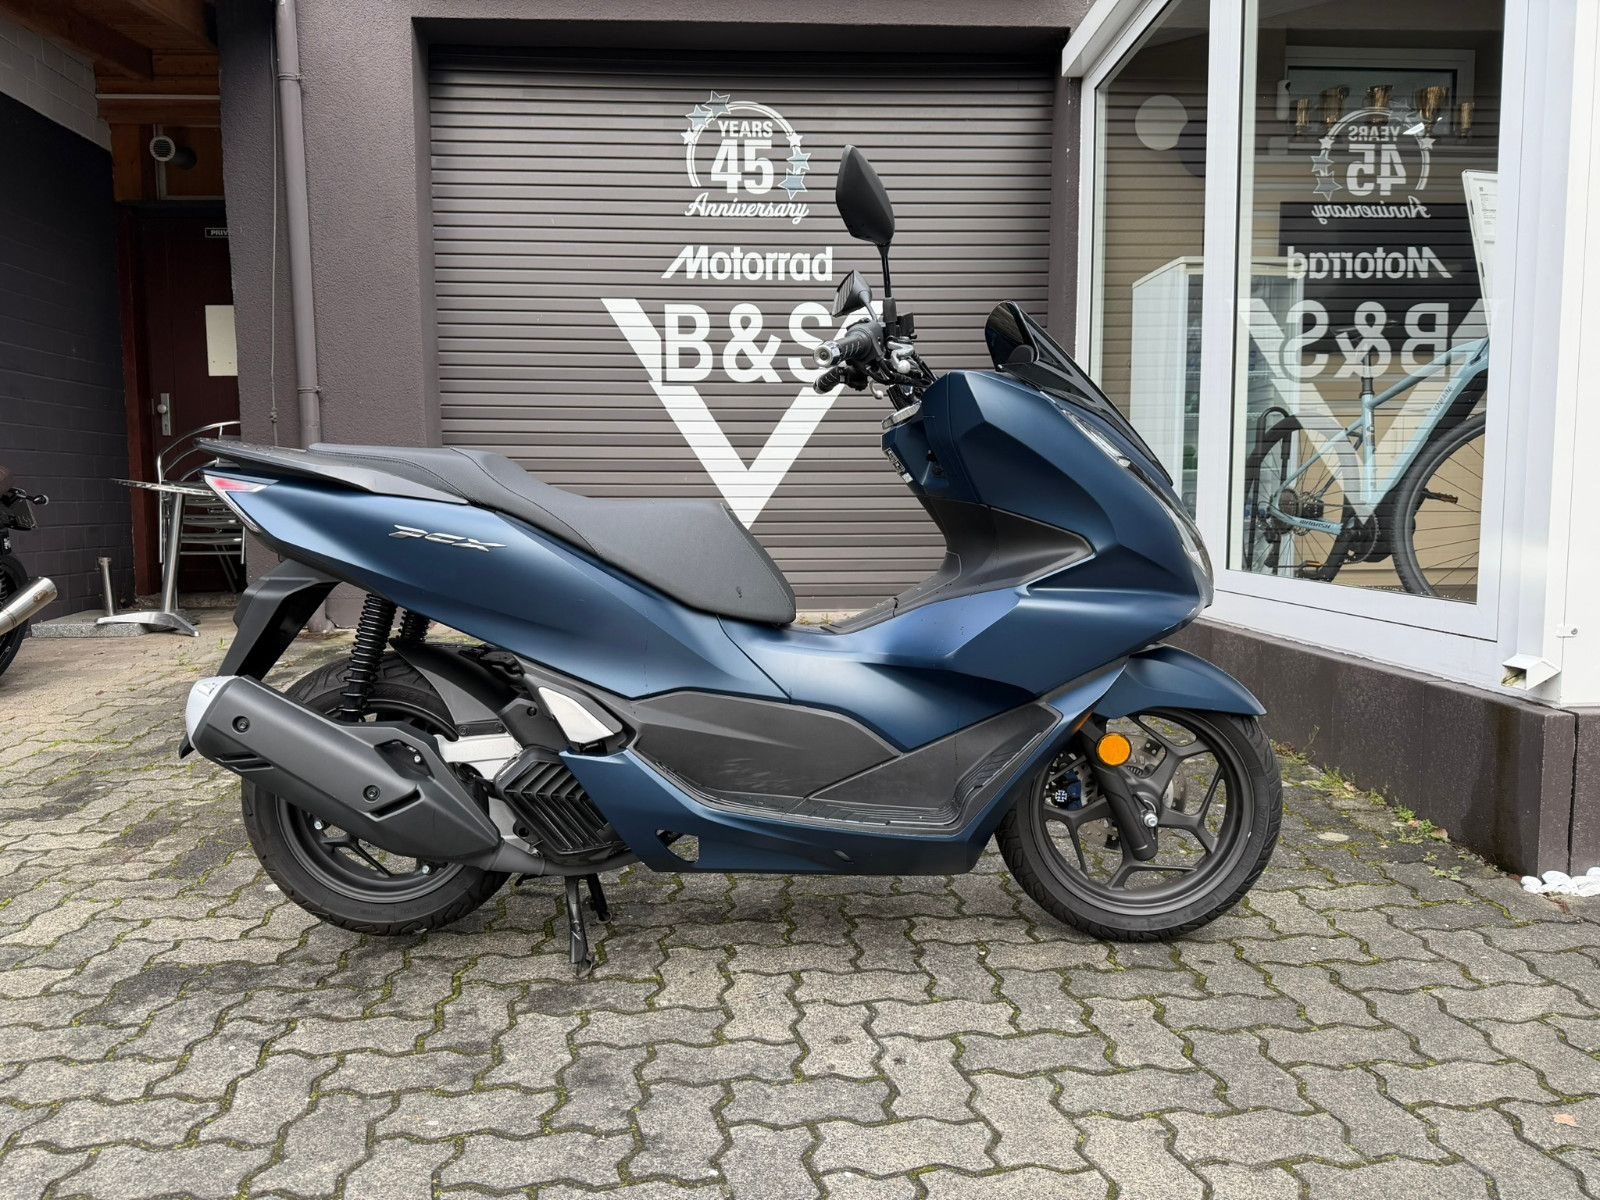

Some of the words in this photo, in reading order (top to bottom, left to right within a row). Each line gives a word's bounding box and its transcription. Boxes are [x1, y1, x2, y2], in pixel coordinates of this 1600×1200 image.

[717, 120, 773, 137] YEARS
[710, 139, 774, 194] 45
[684, 192, 809, 224] Anniversary
[661, 245, 833, 281] Motorrad
